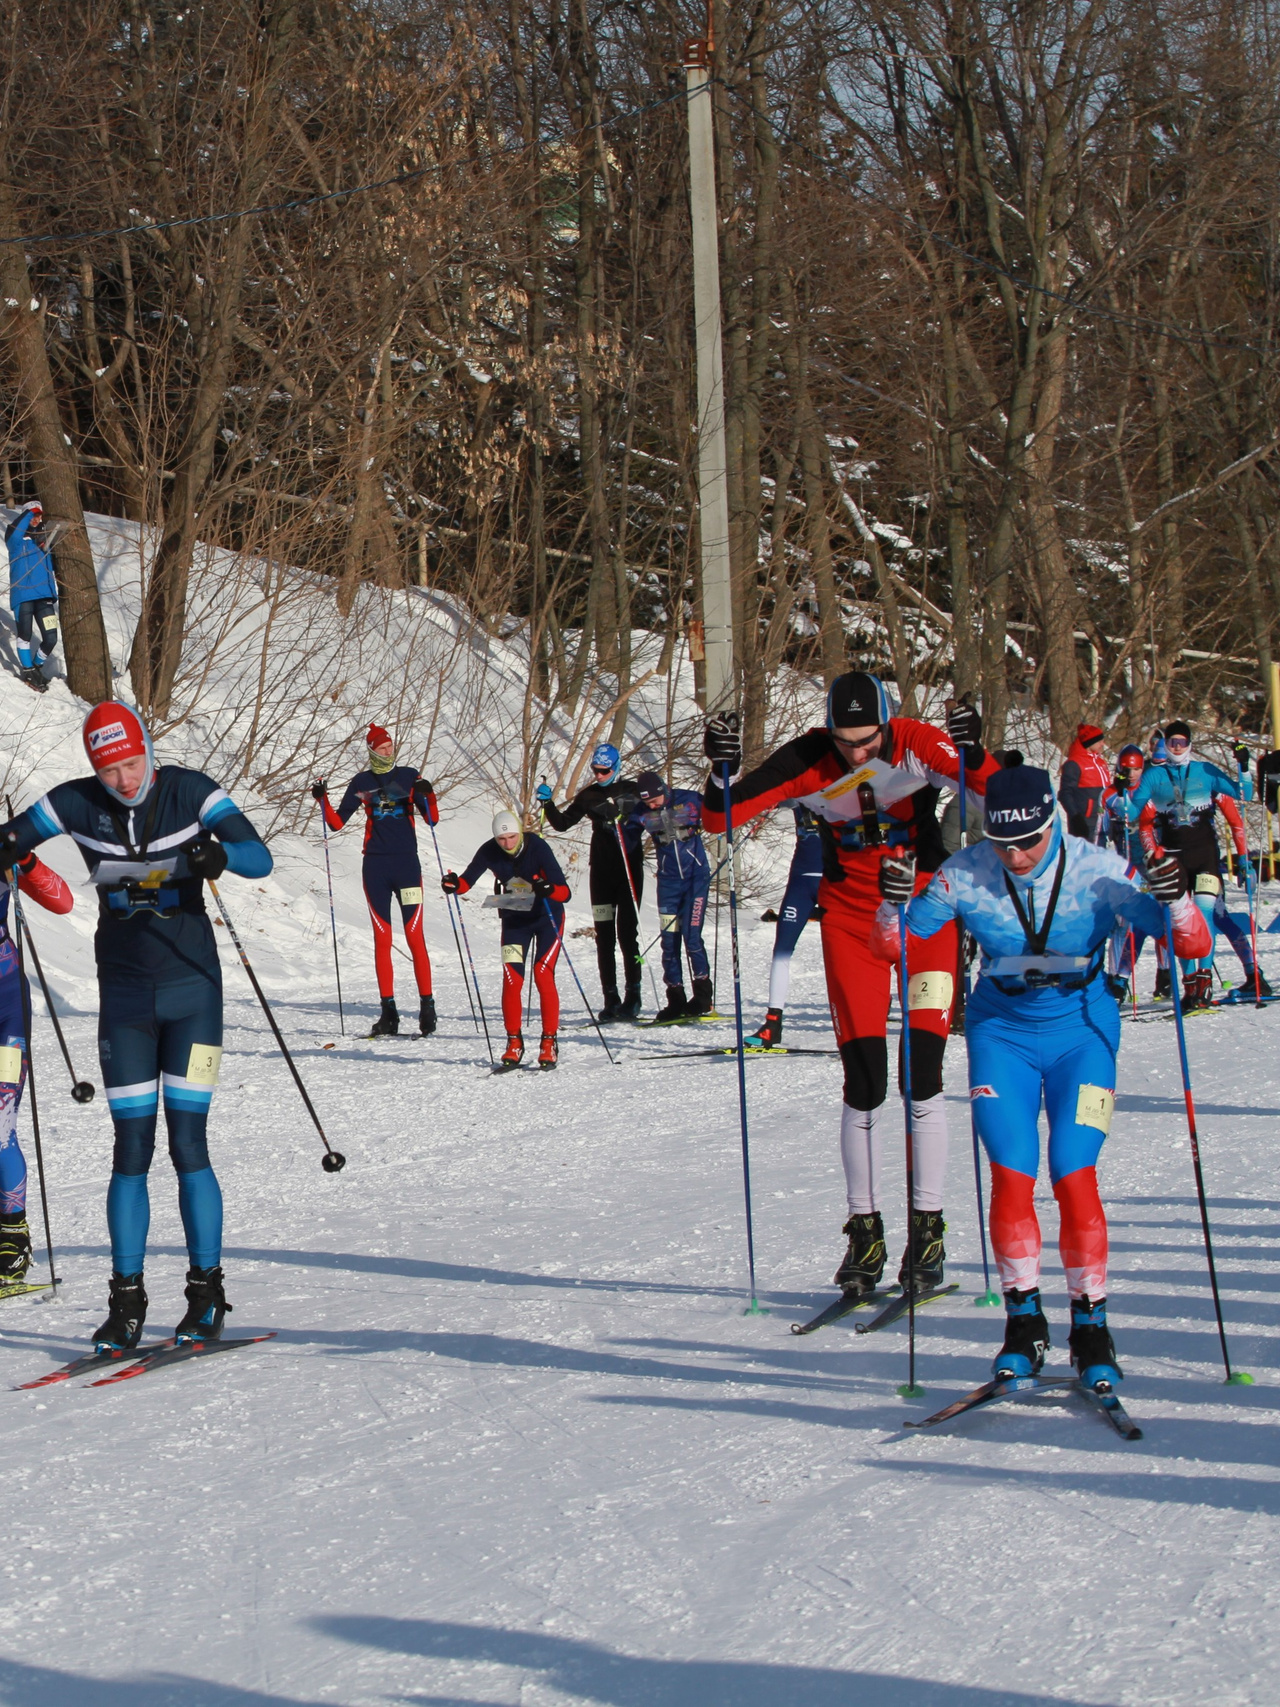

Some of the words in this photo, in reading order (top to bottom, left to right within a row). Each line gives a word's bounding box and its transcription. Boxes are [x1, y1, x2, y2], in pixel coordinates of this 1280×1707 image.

[101, 725, 122, 736] INTER
[102, 730, 124, 742] SPORT
[690, 897, 704, 927] RUSSIA
[920, 981, 928, 992] 2
[206, 1056, 213, 1067] 3
[1099, 1098, 1105, 1110] 1
